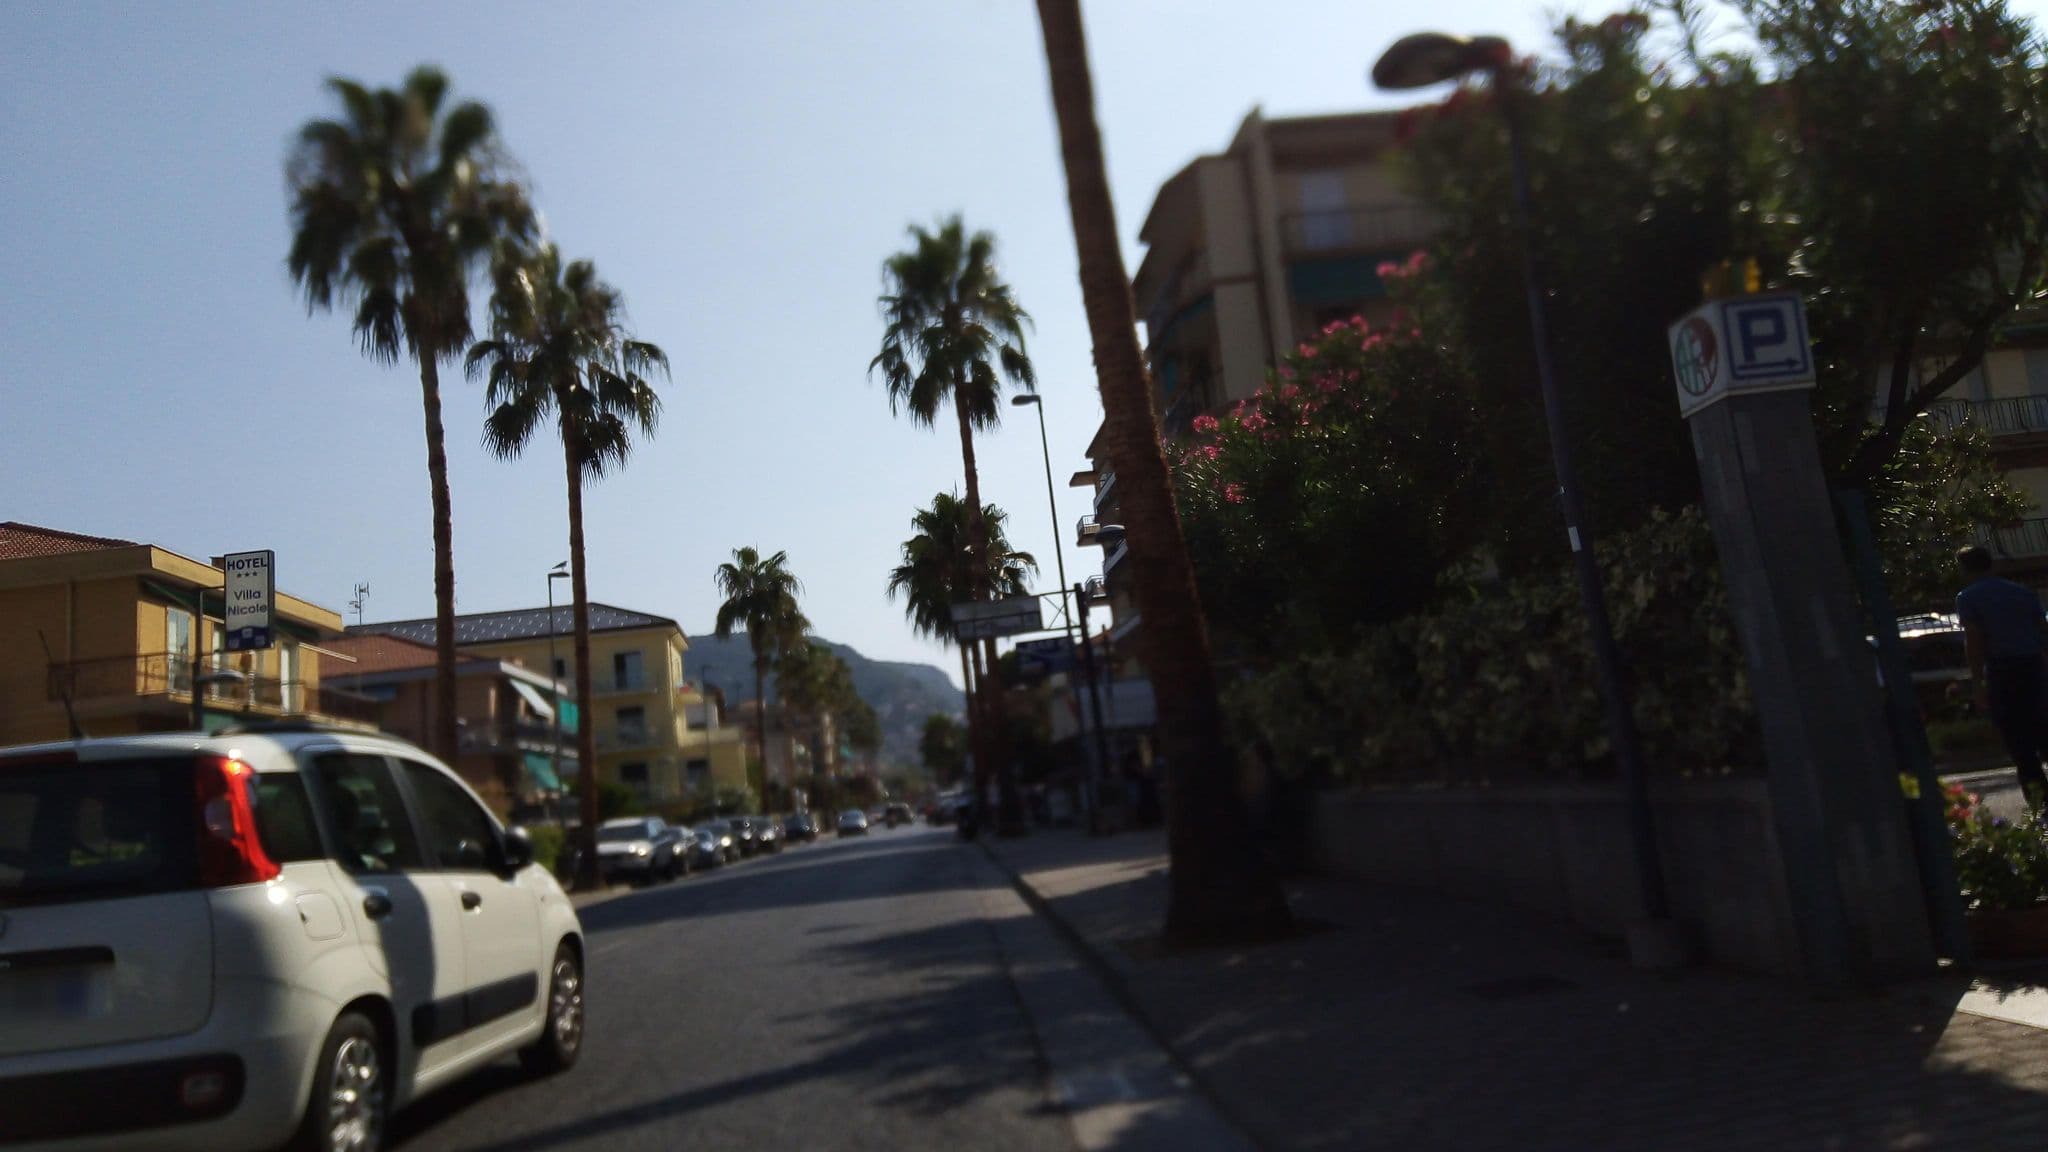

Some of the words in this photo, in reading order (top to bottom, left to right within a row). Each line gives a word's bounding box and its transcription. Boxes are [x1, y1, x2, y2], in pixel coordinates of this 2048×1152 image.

[1737, 308, 1786, 362] P
[227, 558, 267, 571] HOTEL
[234, 589, 261, 601] Villa
[227, 604, 267, 616] Nicole
